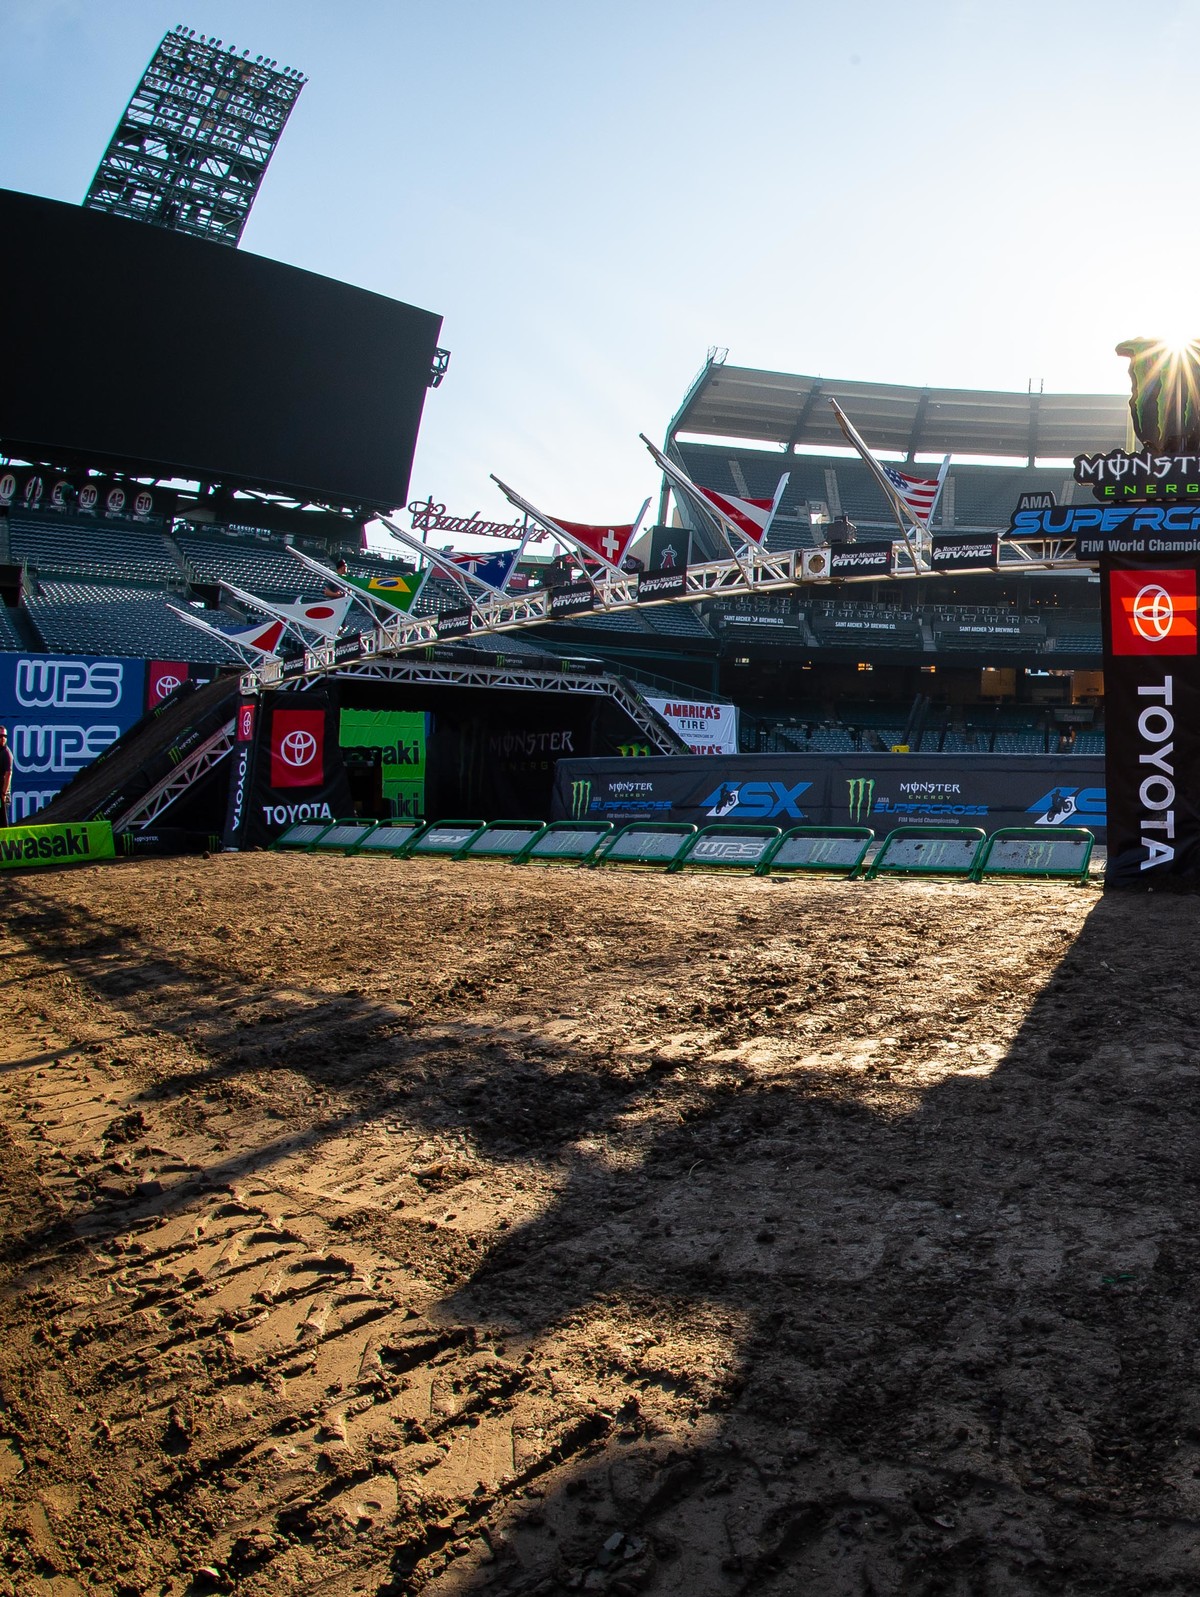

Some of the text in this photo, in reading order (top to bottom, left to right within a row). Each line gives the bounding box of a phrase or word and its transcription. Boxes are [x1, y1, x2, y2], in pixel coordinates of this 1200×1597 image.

[81, 489, 96, 504] 30
[1020, 495, 1051, 509] AMA
[1081, 540, 1105, 553] FIM
[1107, 540, 1145, 553] World
[871, 622, 889, 630] BREWING
[15, 660, 123, 708] WPS
[663, 703, 721, 720] AMERICA'S
[680, 720, 706, 730] TIRE
[1137, 675, 1176, 871] TOYOTA
[231, 748, 248, 831] TOYOTA
[608, 781, 653, 793] MONSTER
[900, 781, 961, 794] MONSTER
[590, 800, 673, 811] SUPERCROSS
[873, 803, 989, 816] SUPERCROSS
[263, 802, 332, 825] TOYOTA
[0, 827, 90, 862] wasaki
[693, 842, 765, 858] WPS
